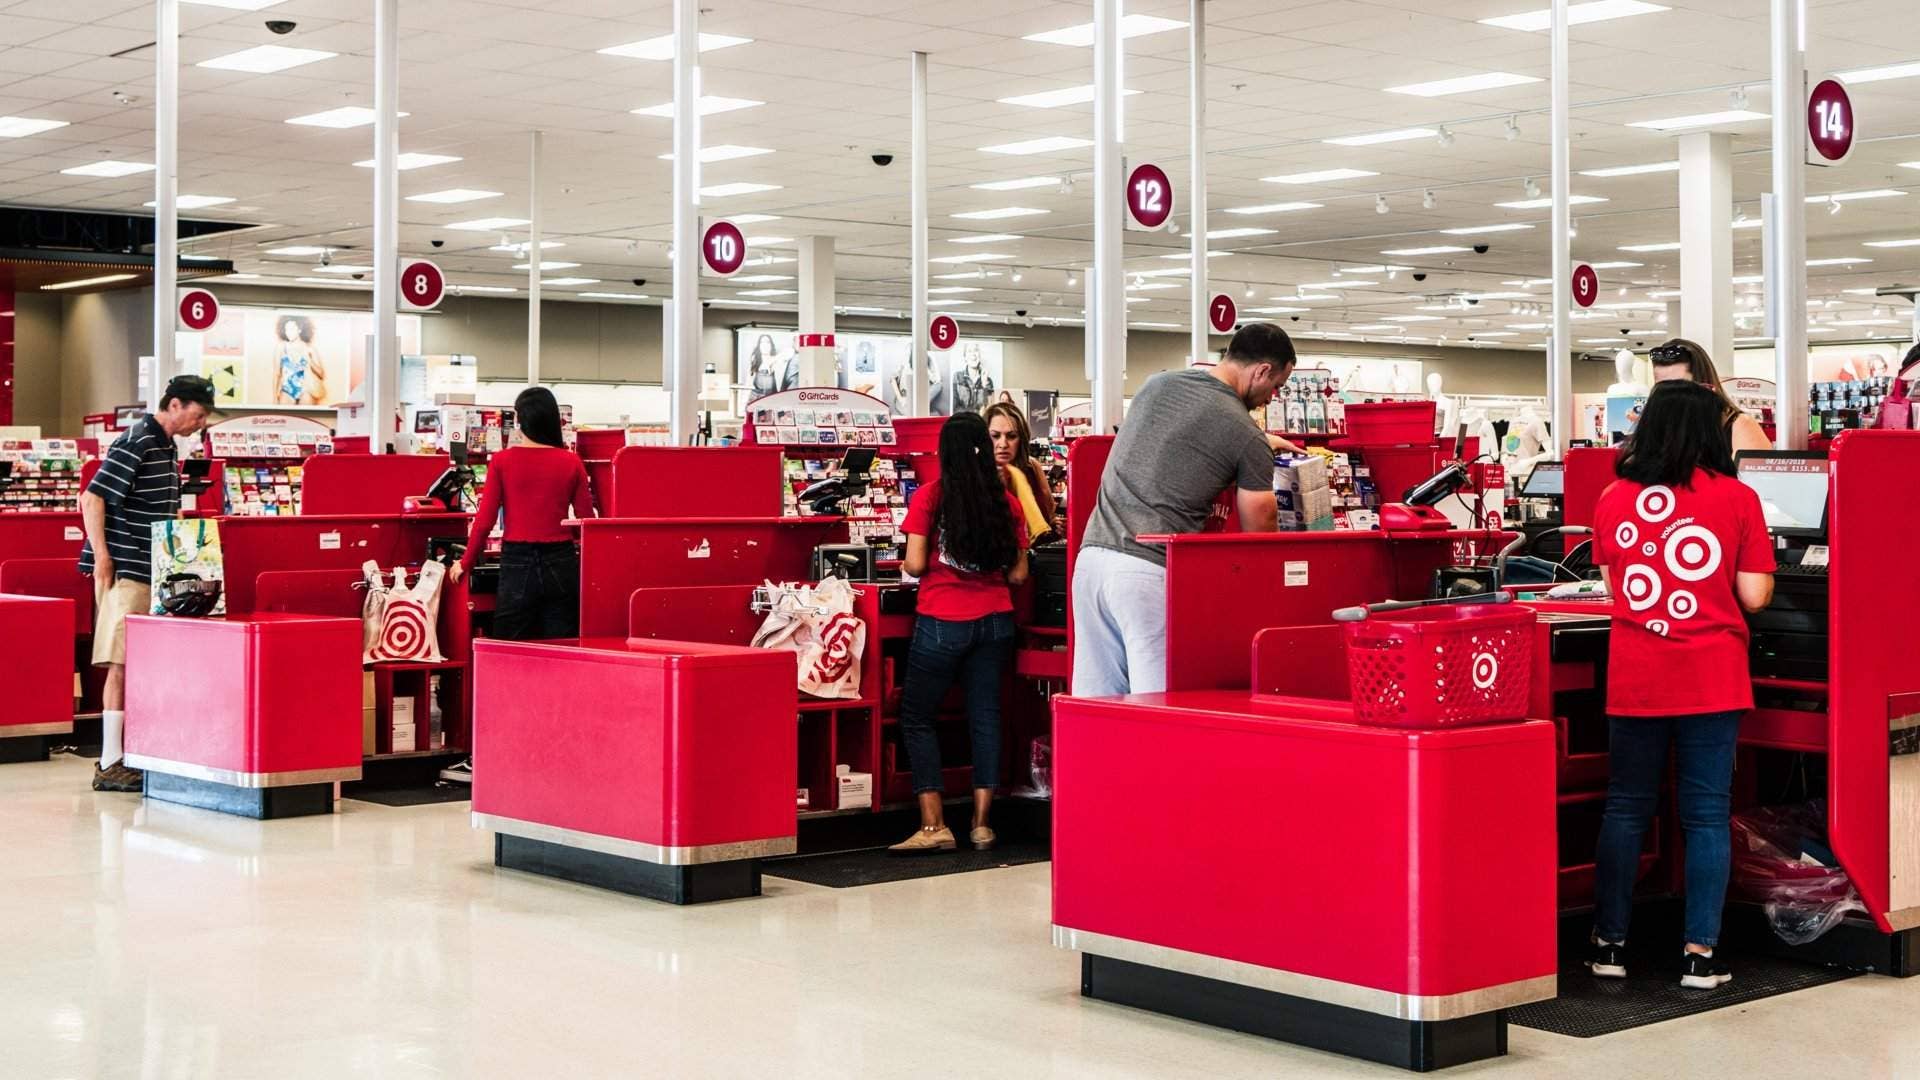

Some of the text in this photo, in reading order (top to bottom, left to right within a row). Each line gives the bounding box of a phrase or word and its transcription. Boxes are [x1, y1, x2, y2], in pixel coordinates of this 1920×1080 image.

[1815, 100, 1845, 141] 14
[1135, 179, 1162, 213] 12
[710, 234, 736, 263] 10
[414, 274, 428, 295] 8
[1580, 276, 1589, 296] 9
[191, 301, 204, 320] 6
[1217, 304, 1227, 322] 7
[939, 324, 949, 341] 5
[1660, 516, 1695, 539] volunteer
